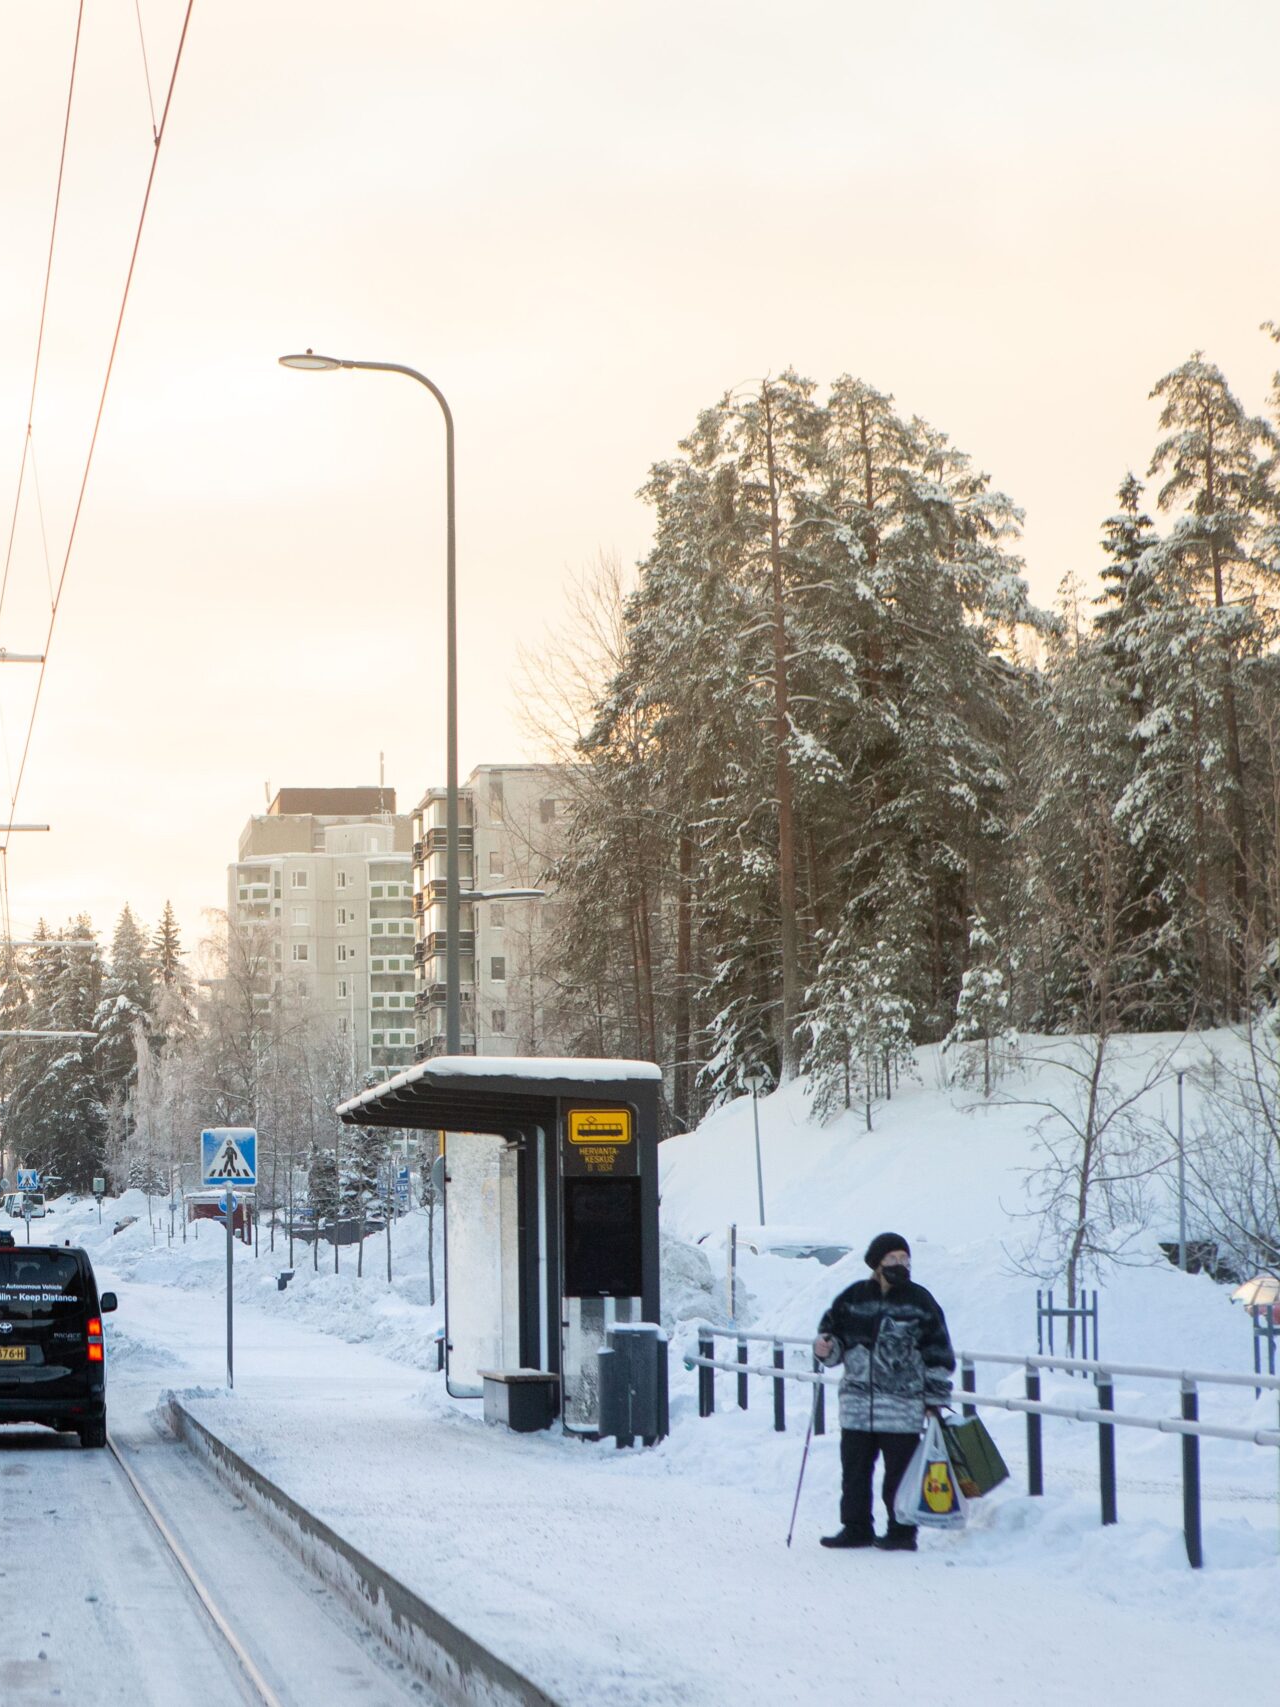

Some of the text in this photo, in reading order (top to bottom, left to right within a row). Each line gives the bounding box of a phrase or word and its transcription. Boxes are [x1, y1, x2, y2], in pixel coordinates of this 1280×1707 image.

[579, 1147, 620, 1155] HERVANTA-
[584, 1155, 615, 1163] KESKUS
[396, 1167, 407, 1179] P
[18, 1293, 41, 1303] Keep
[42, 1293, 78, 1302] Distance
